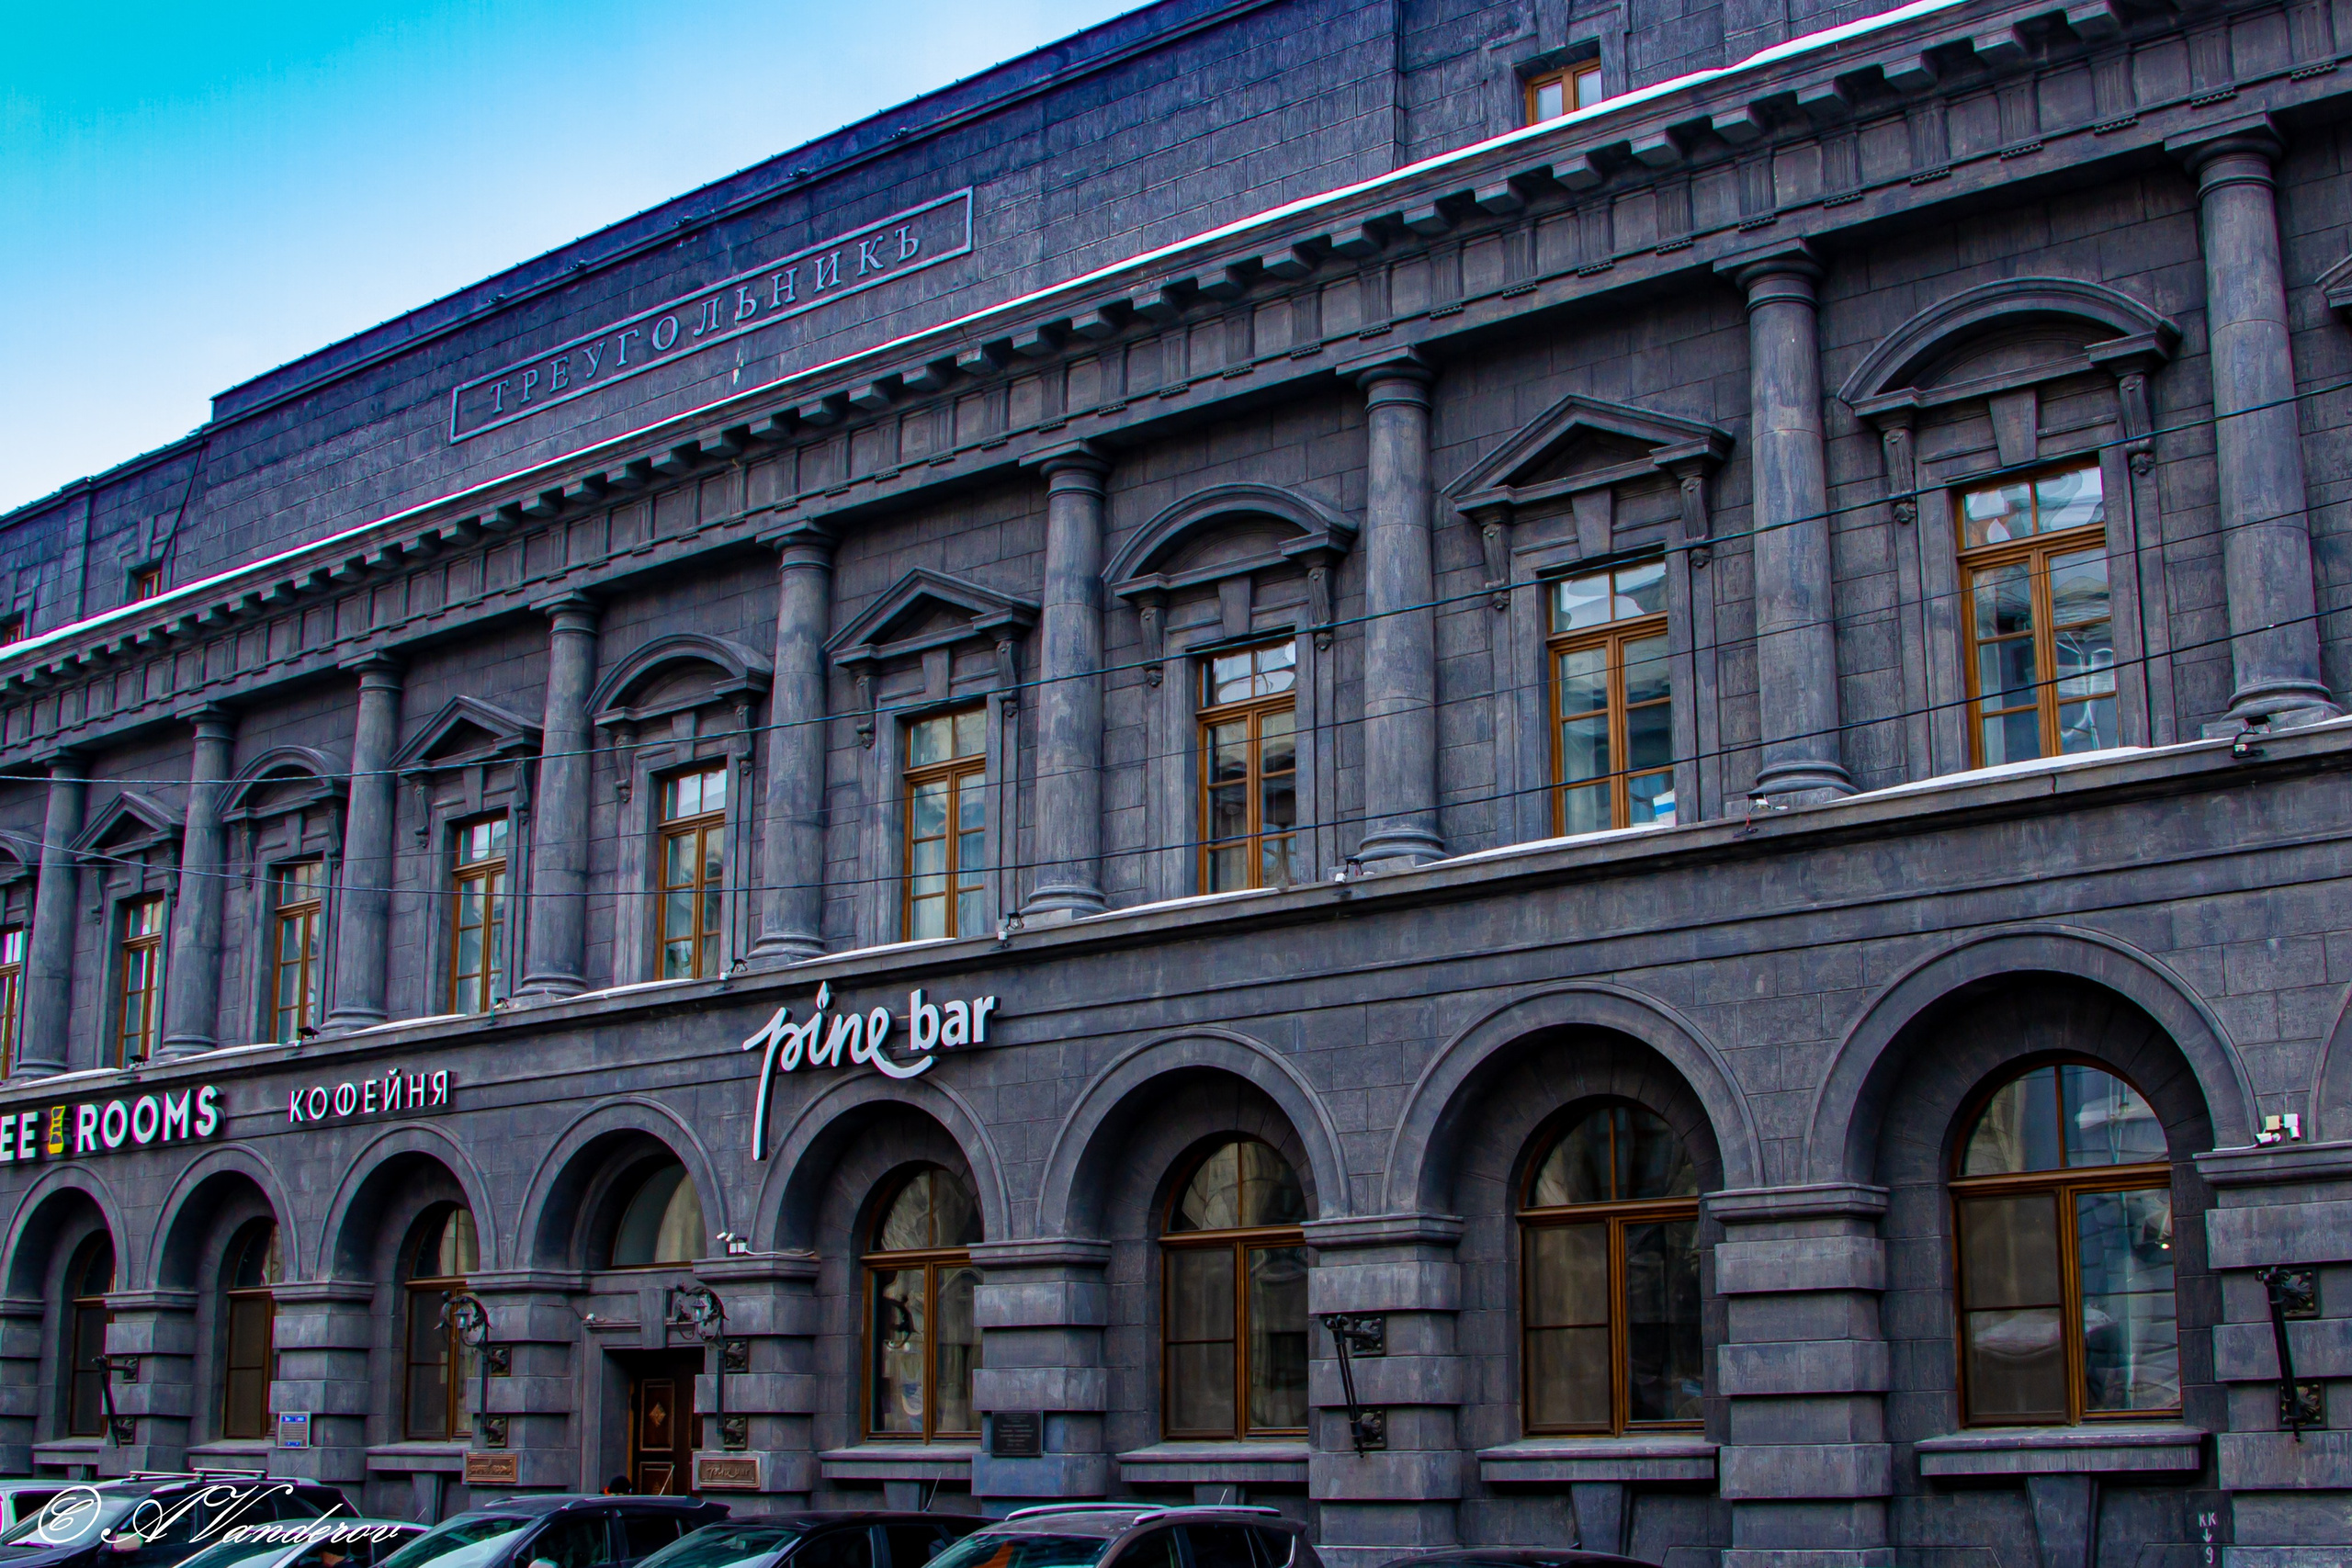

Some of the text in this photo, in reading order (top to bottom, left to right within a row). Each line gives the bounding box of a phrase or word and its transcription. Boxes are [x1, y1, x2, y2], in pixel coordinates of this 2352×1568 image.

[490, 225, 920, 414] ТРЕУГОЛЬНИКЪ
[76, 1085, 219, 1153] ROOMS
[289, 1068, 450, 1122] КОФЕЙНЯ
[742, 980, 995, 1161] pine bar
